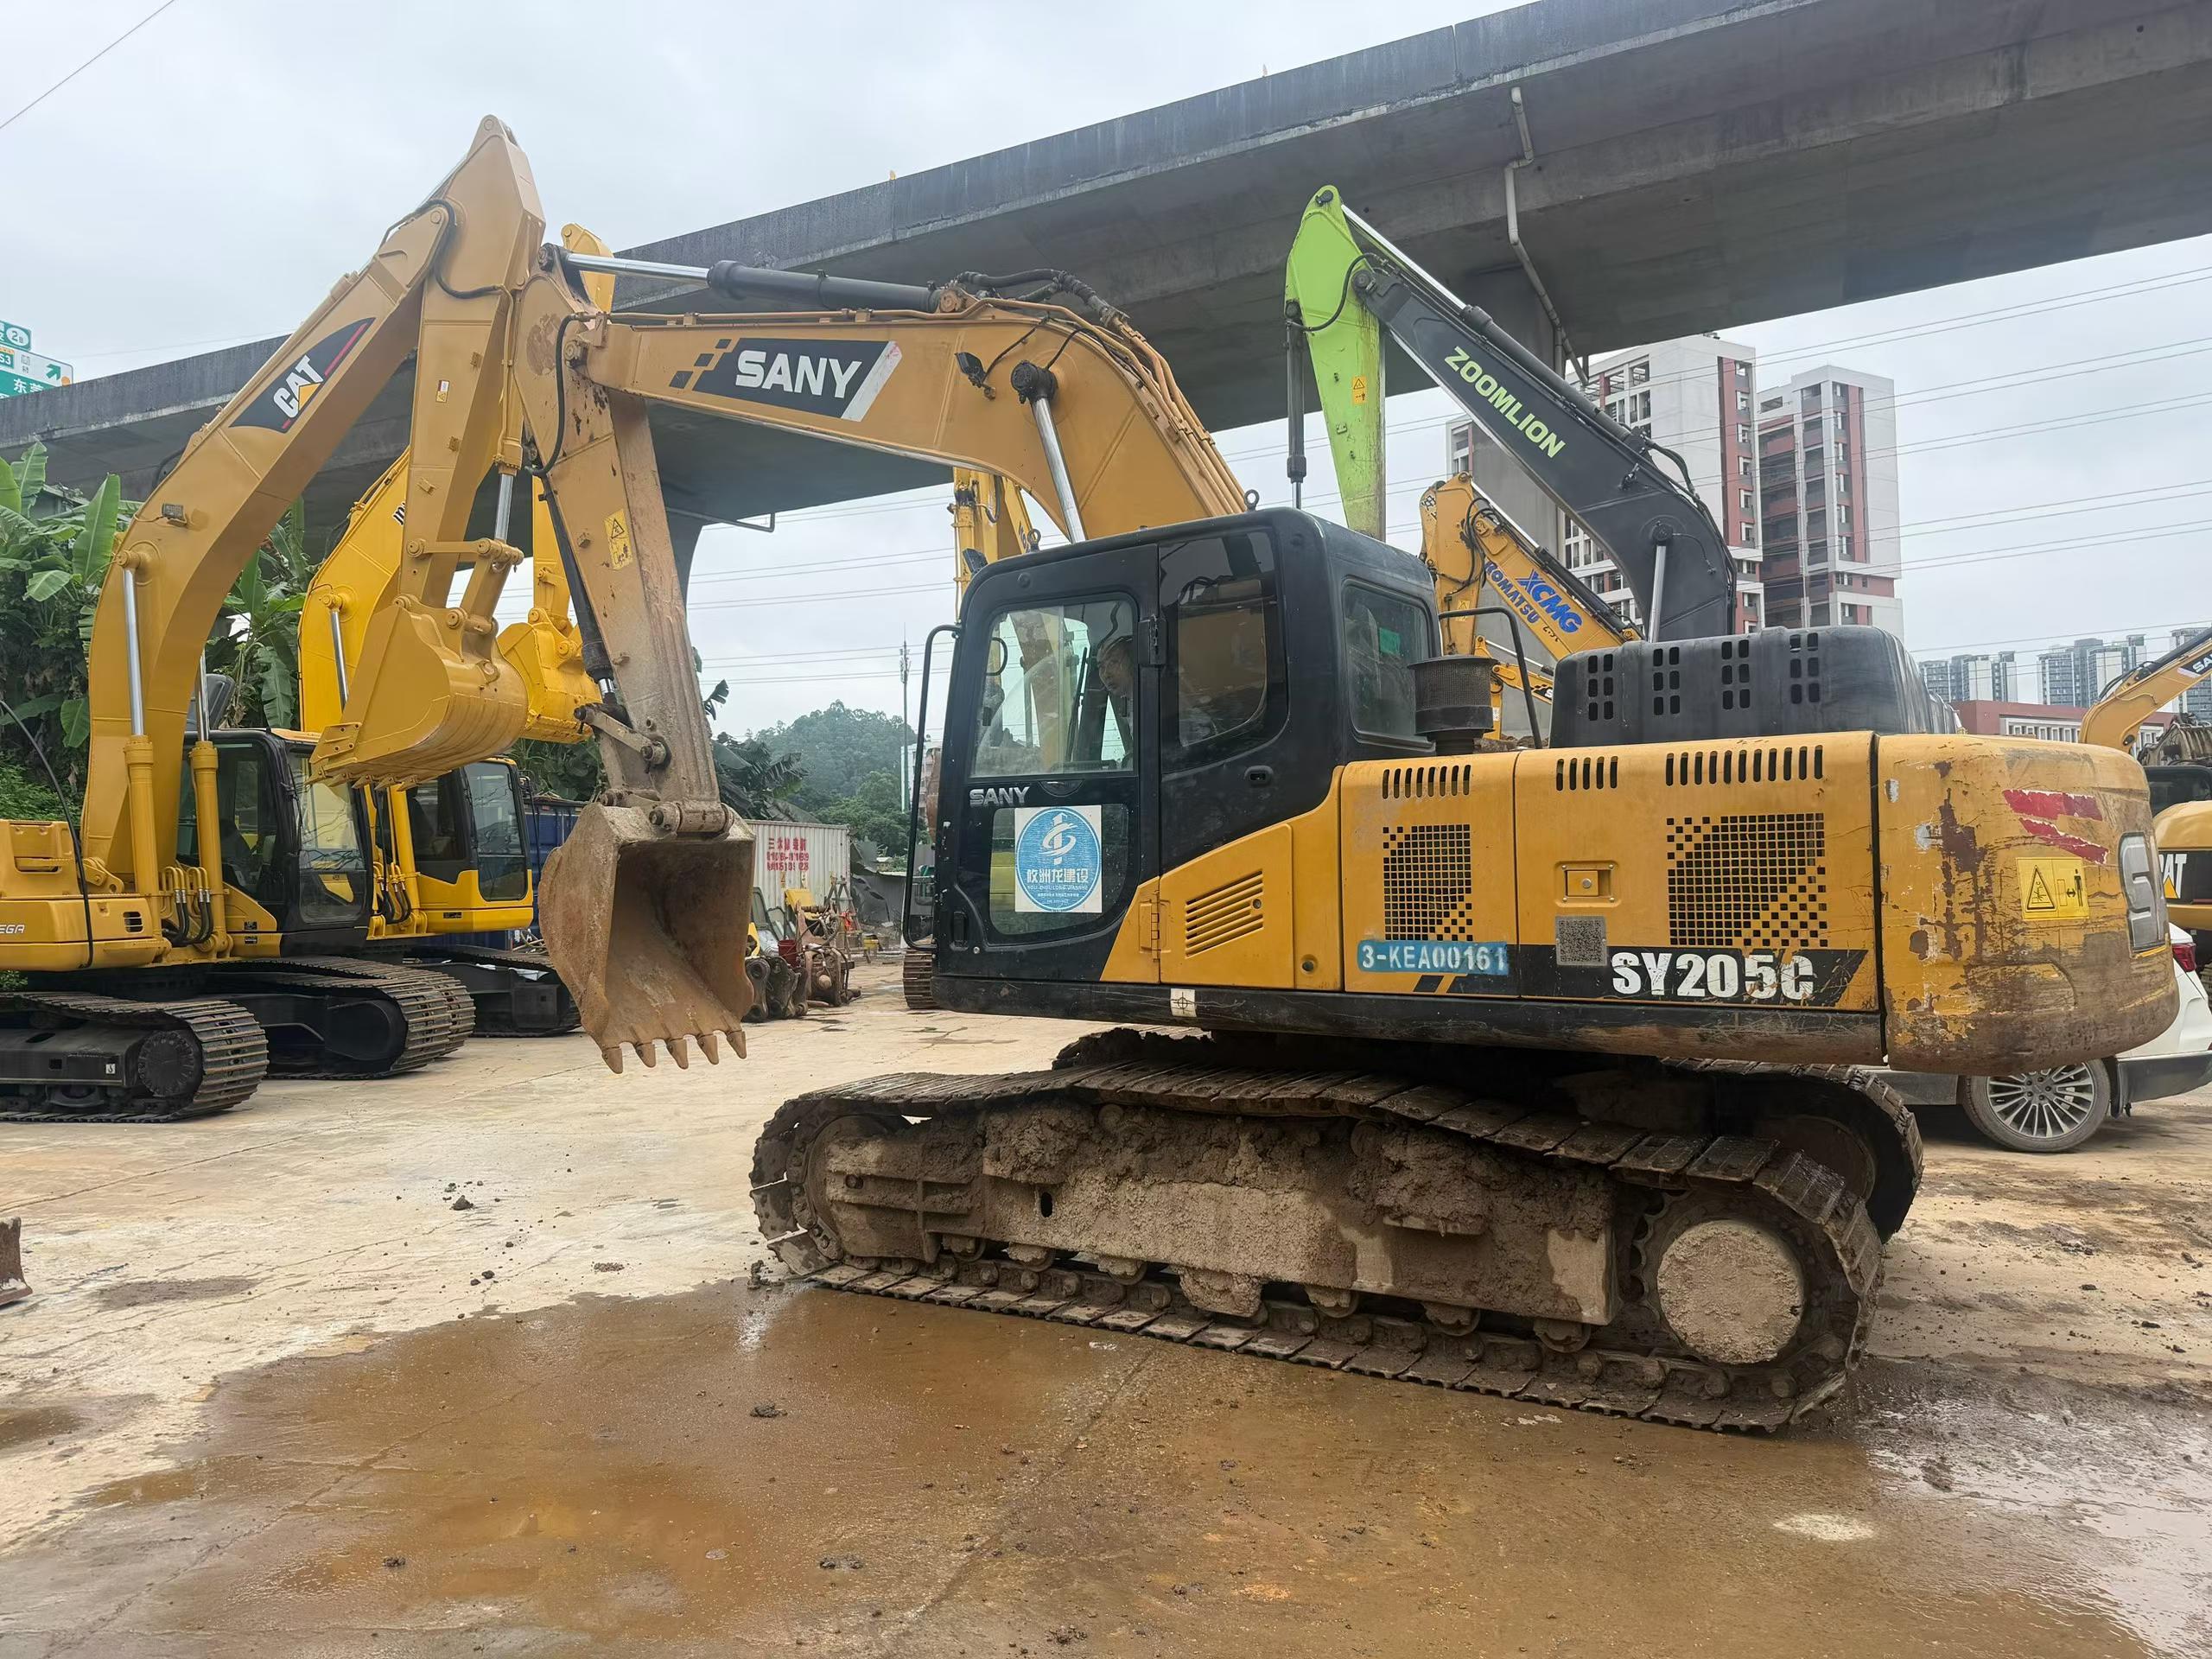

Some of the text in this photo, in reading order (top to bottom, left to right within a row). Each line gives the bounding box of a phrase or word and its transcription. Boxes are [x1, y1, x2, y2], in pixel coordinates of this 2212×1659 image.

[273, 354, 324, 418] CAT
[735, 350, 862, 398] SANY
[1444, 346, 1567, 458] ZOOMLION
[1484, 561, 1541, 624] KOMATSU
[1515, 569, 1583, 633] XCMG
[2192, 654, 2212, 673] SA
[969, 786, 1031, 807] SANY
[2158, 853, 2188, 899] AT
[1362, 944, 1504, 971] 3-KEA00161
[1611, 951, 1815, 1001] SY205C
